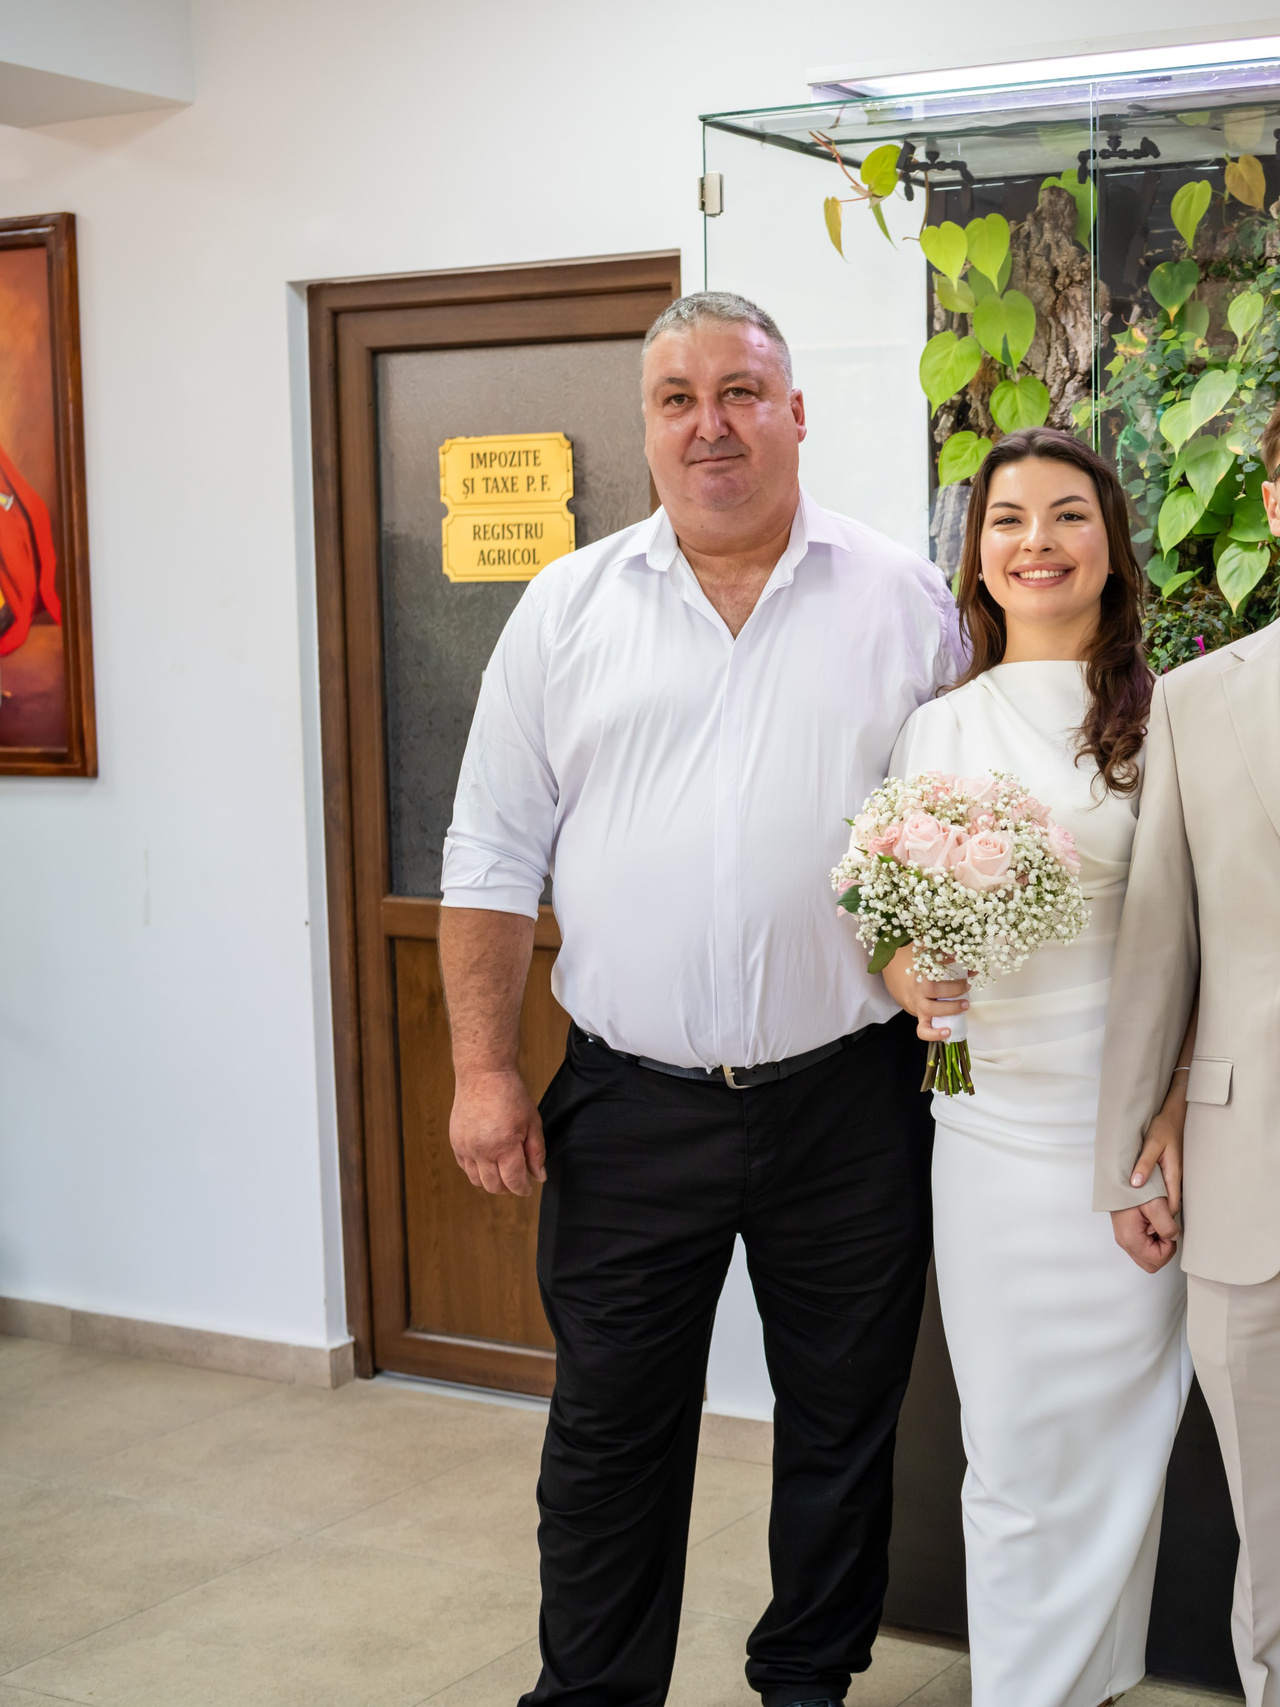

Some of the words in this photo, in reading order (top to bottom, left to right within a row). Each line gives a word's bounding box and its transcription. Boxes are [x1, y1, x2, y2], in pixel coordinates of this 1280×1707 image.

[470, 449, 541, 469] IMPOZITE
[482, 475, 519, 494] TAXE
[472, 522, 544, 542] REGISTRU
[477, 548, 540, 567] AGRICOL
